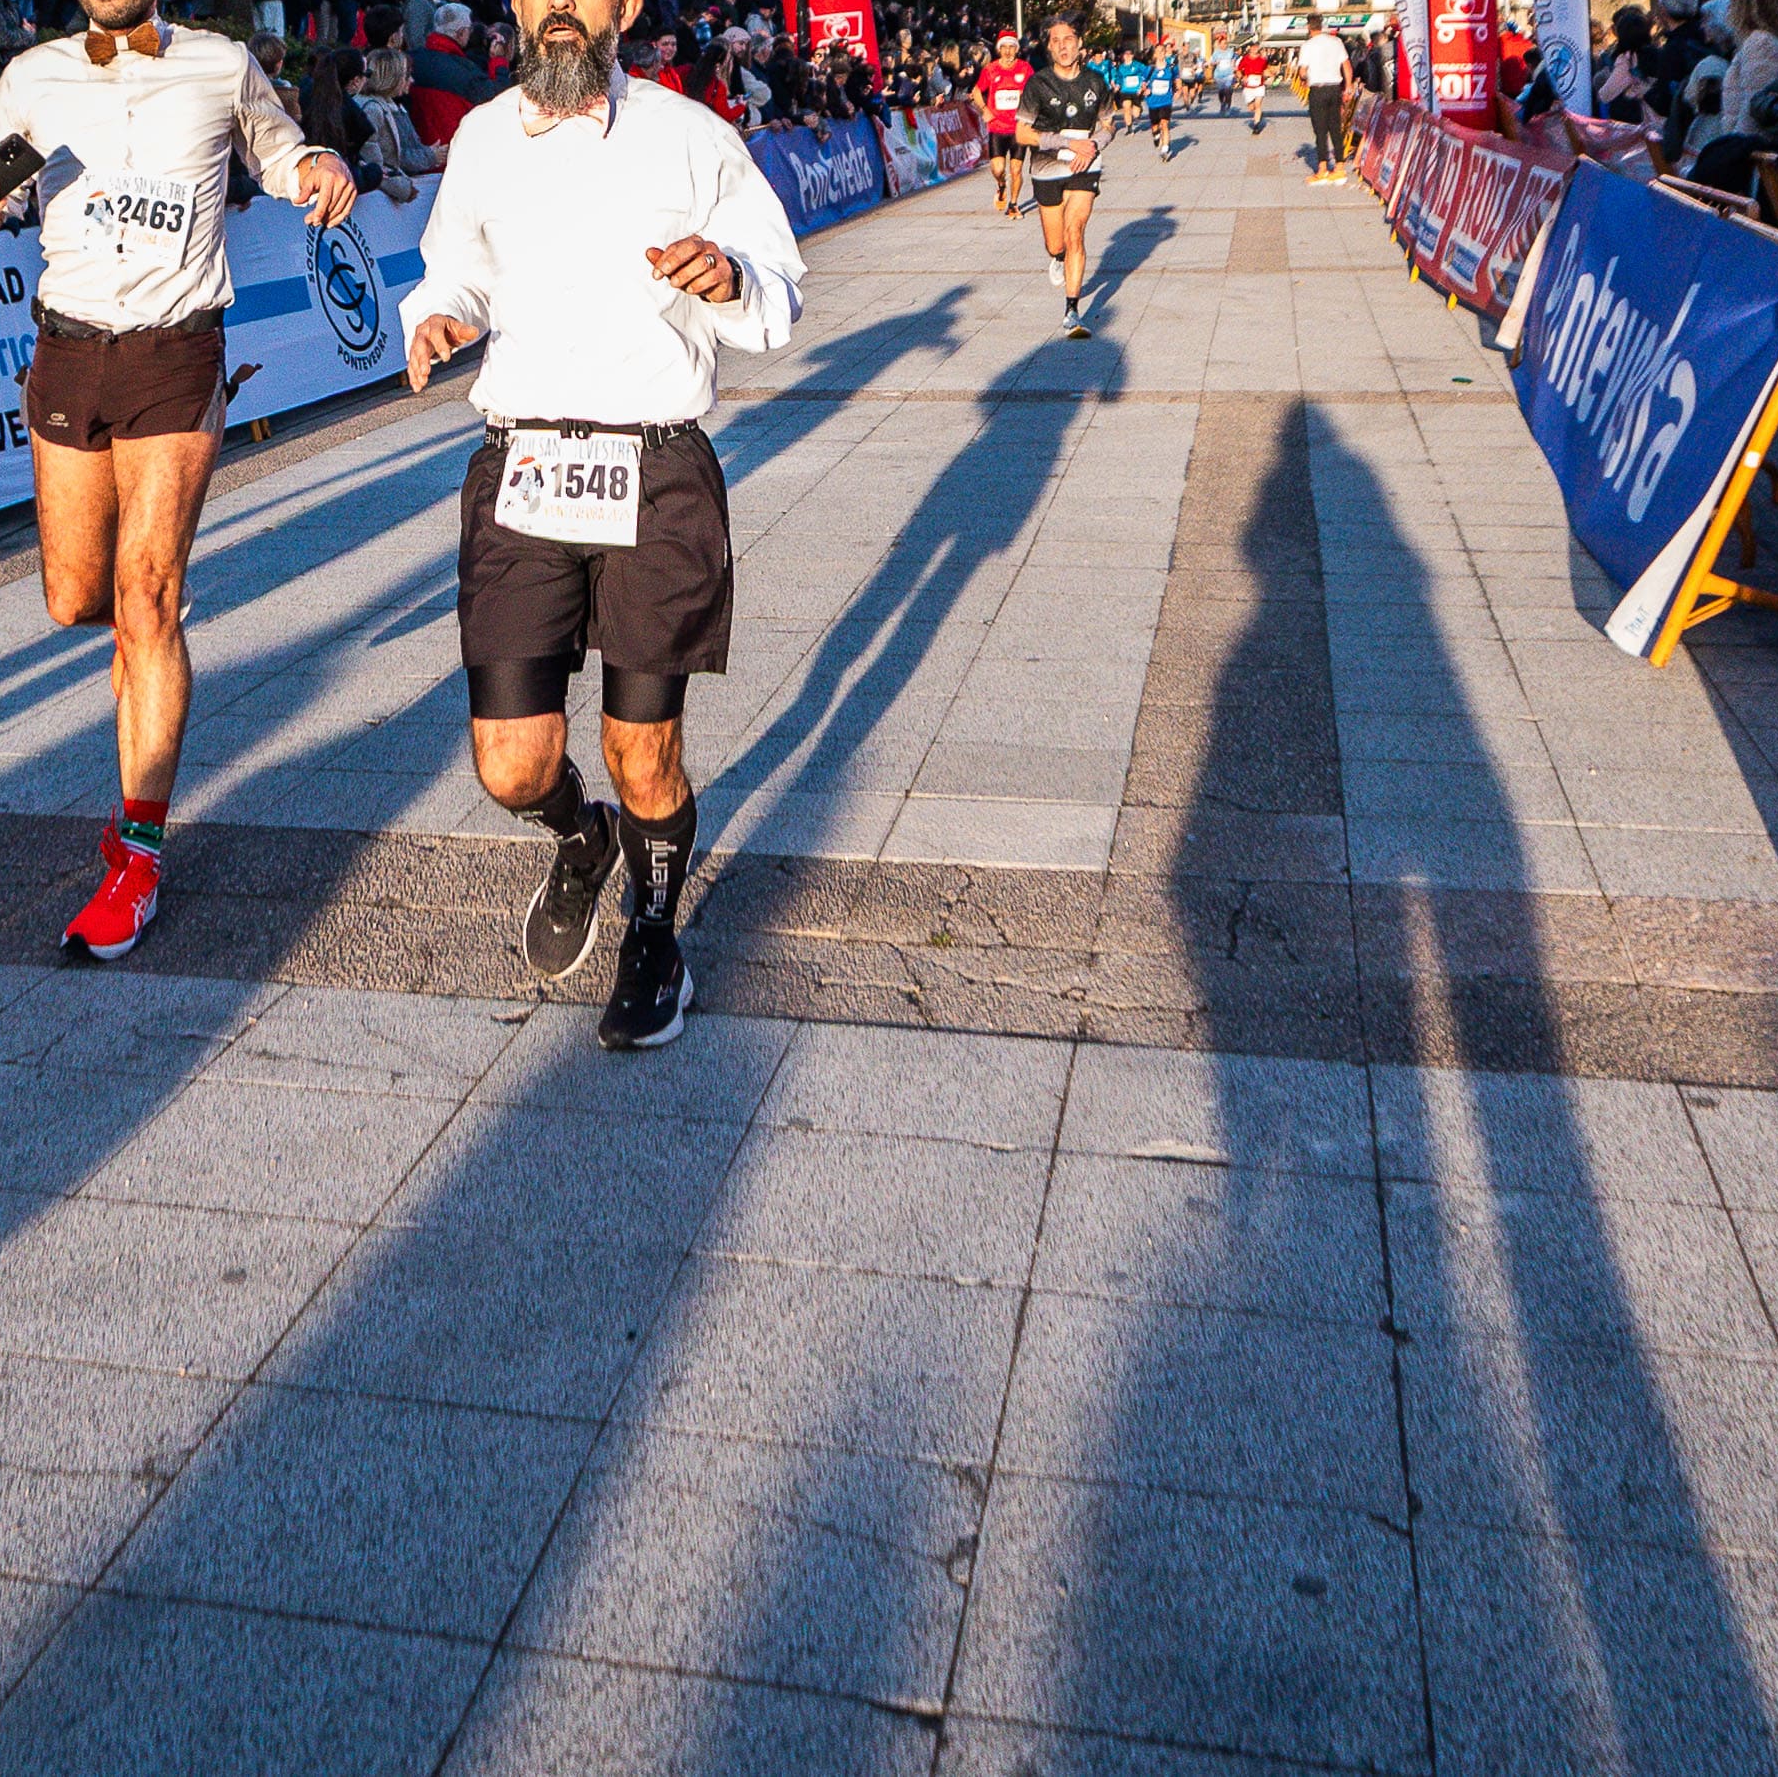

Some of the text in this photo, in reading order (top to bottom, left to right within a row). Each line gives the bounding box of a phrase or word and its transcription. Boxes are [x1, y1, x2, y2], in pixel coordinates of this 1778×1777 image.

[789, 131, 873, 213] Pontevedra
[116, 194, 185, 233] 2463
[337, 330, 388, 372] PONTEVEDRA
[550, 462, 629, 501] 1548
